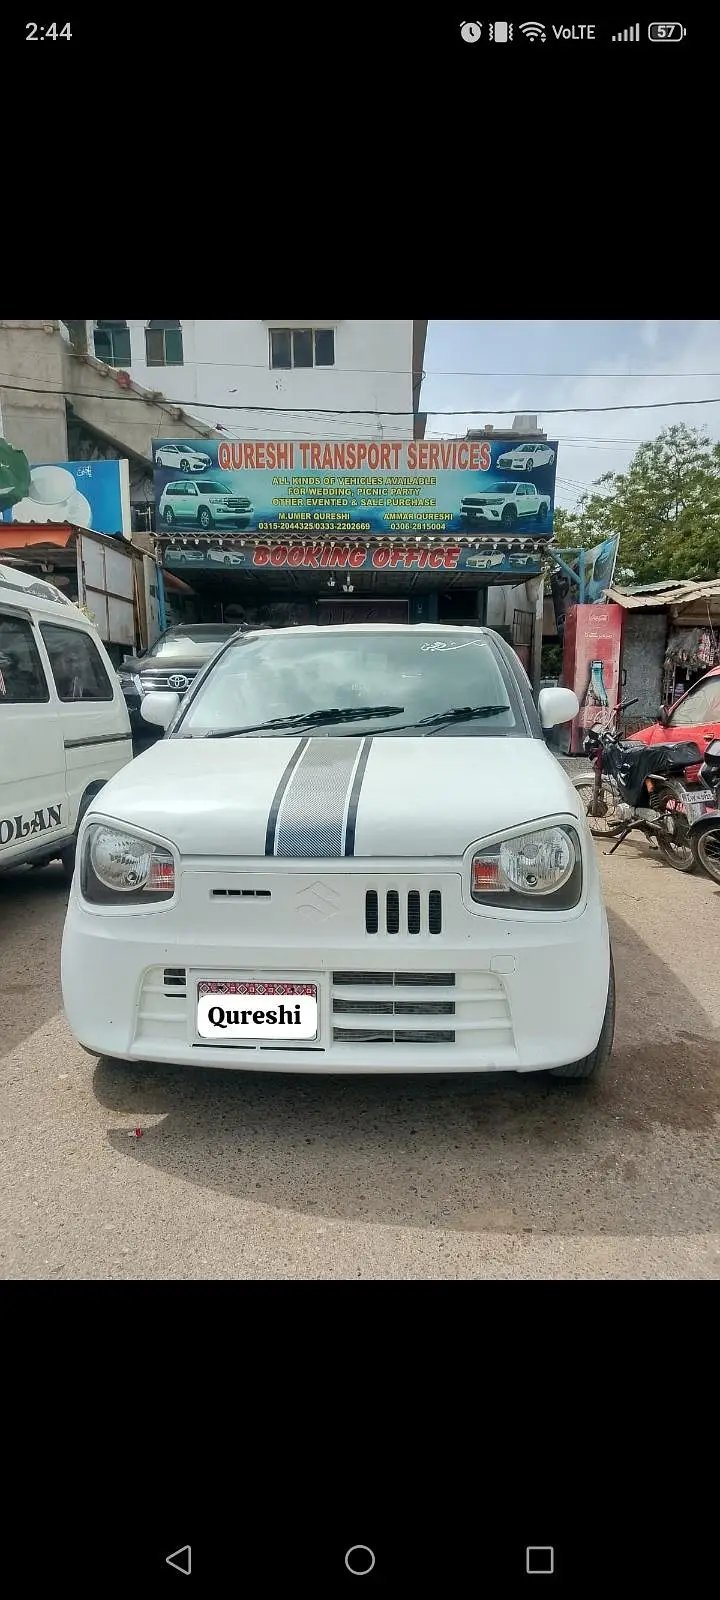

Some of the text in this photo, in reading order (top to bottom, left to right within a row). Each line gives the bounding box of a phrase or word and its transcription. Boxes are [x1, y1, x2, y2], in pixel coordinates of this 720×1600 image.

[219, 441, 491, 471] QURESHI TRANSPORT SERVICES
[272, 476, 437, 485] ALL KINDS OF VEHICLES AVAILABLE
[288, 487, 421, 497] FOR WEDDING, PICNIC PARTY
[272, 498, 436, 506] OTHER EVENTED & SALE PURCHASE
[278, 512, 350, 520] M.UMER QURESHI
[384, 512, 453, 520] AMMAR QURESHI
[252, 545, 462, 569] BOOKING OFFICE
